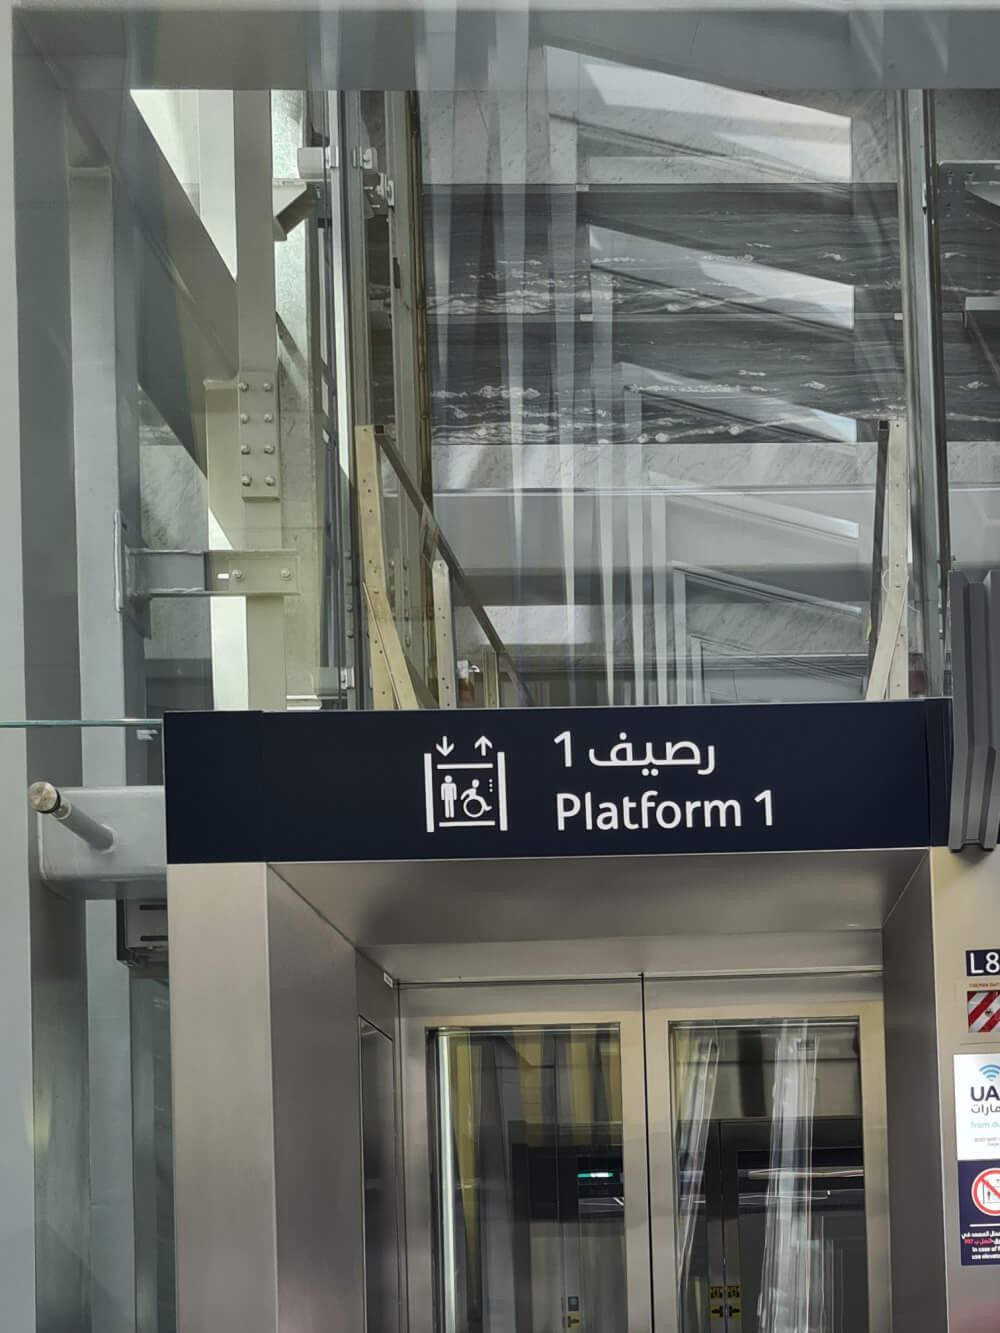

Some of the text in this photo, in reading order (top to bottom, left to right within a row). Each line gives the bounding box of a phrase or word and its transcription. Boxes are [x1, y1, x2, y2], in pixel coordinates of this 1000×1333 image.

[553, 730, 717, 776] رصيف 1
[555, 789, 775, 831] Platform 1
[969, 951, 1000, 974] L8
